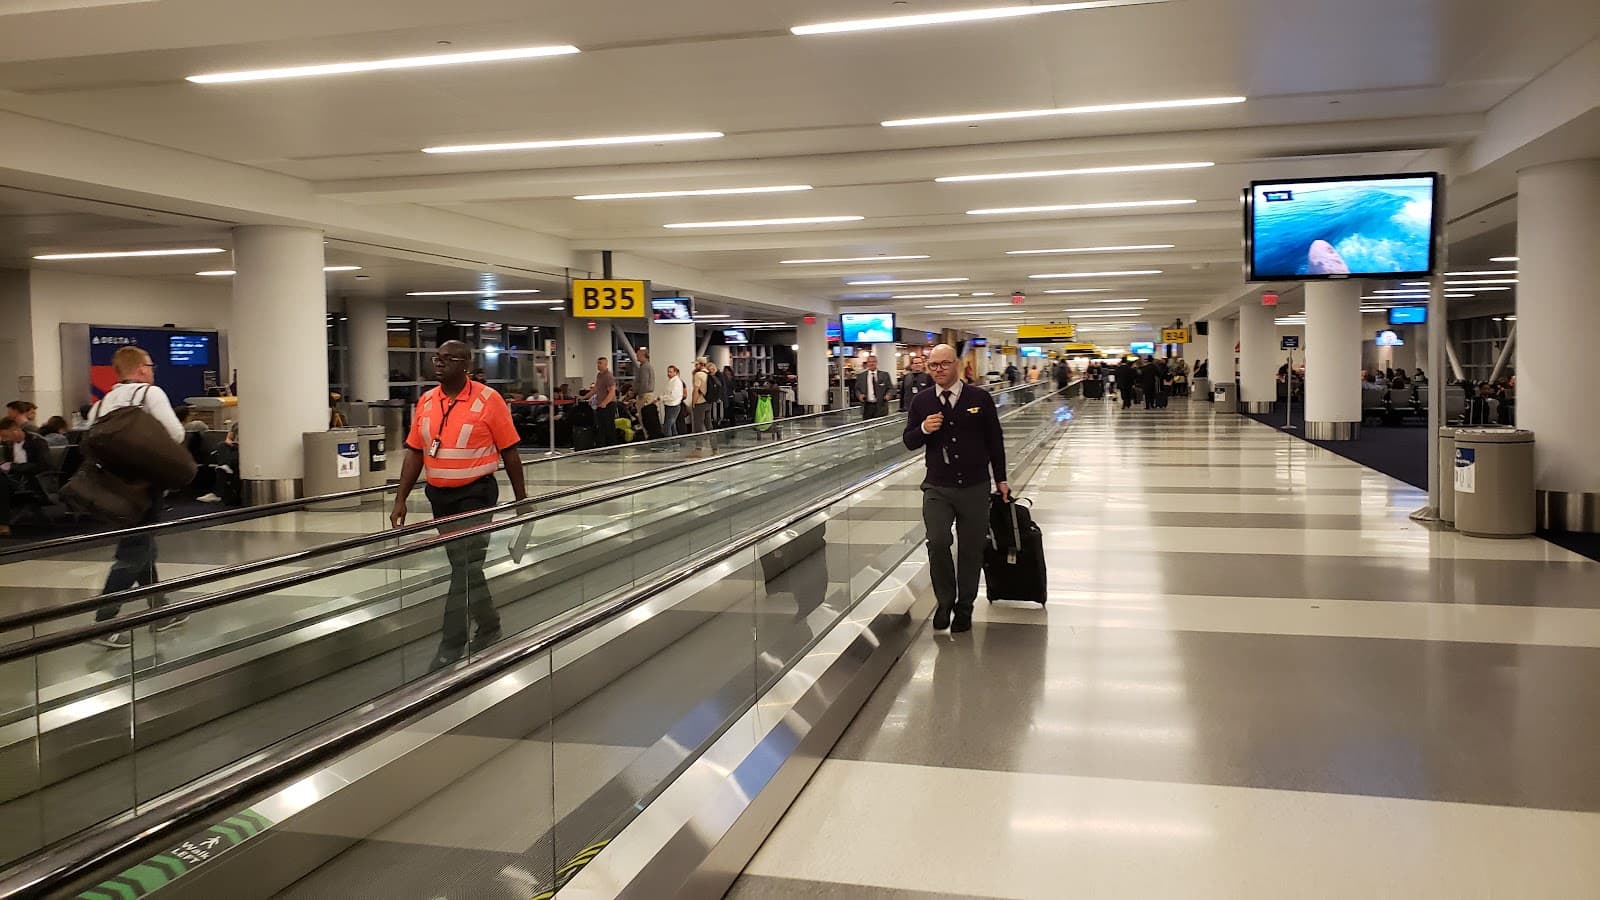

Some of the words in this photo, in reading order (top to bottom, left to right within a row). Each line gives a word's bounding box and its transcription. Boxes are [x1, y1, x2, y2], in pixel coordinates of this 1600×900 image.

[583, 287, 634, 310] B35
[100, 336, 130, 345] DELTA
[171, 847, 201, 864] LEFT
[182, 841, 210, 860] Walk
